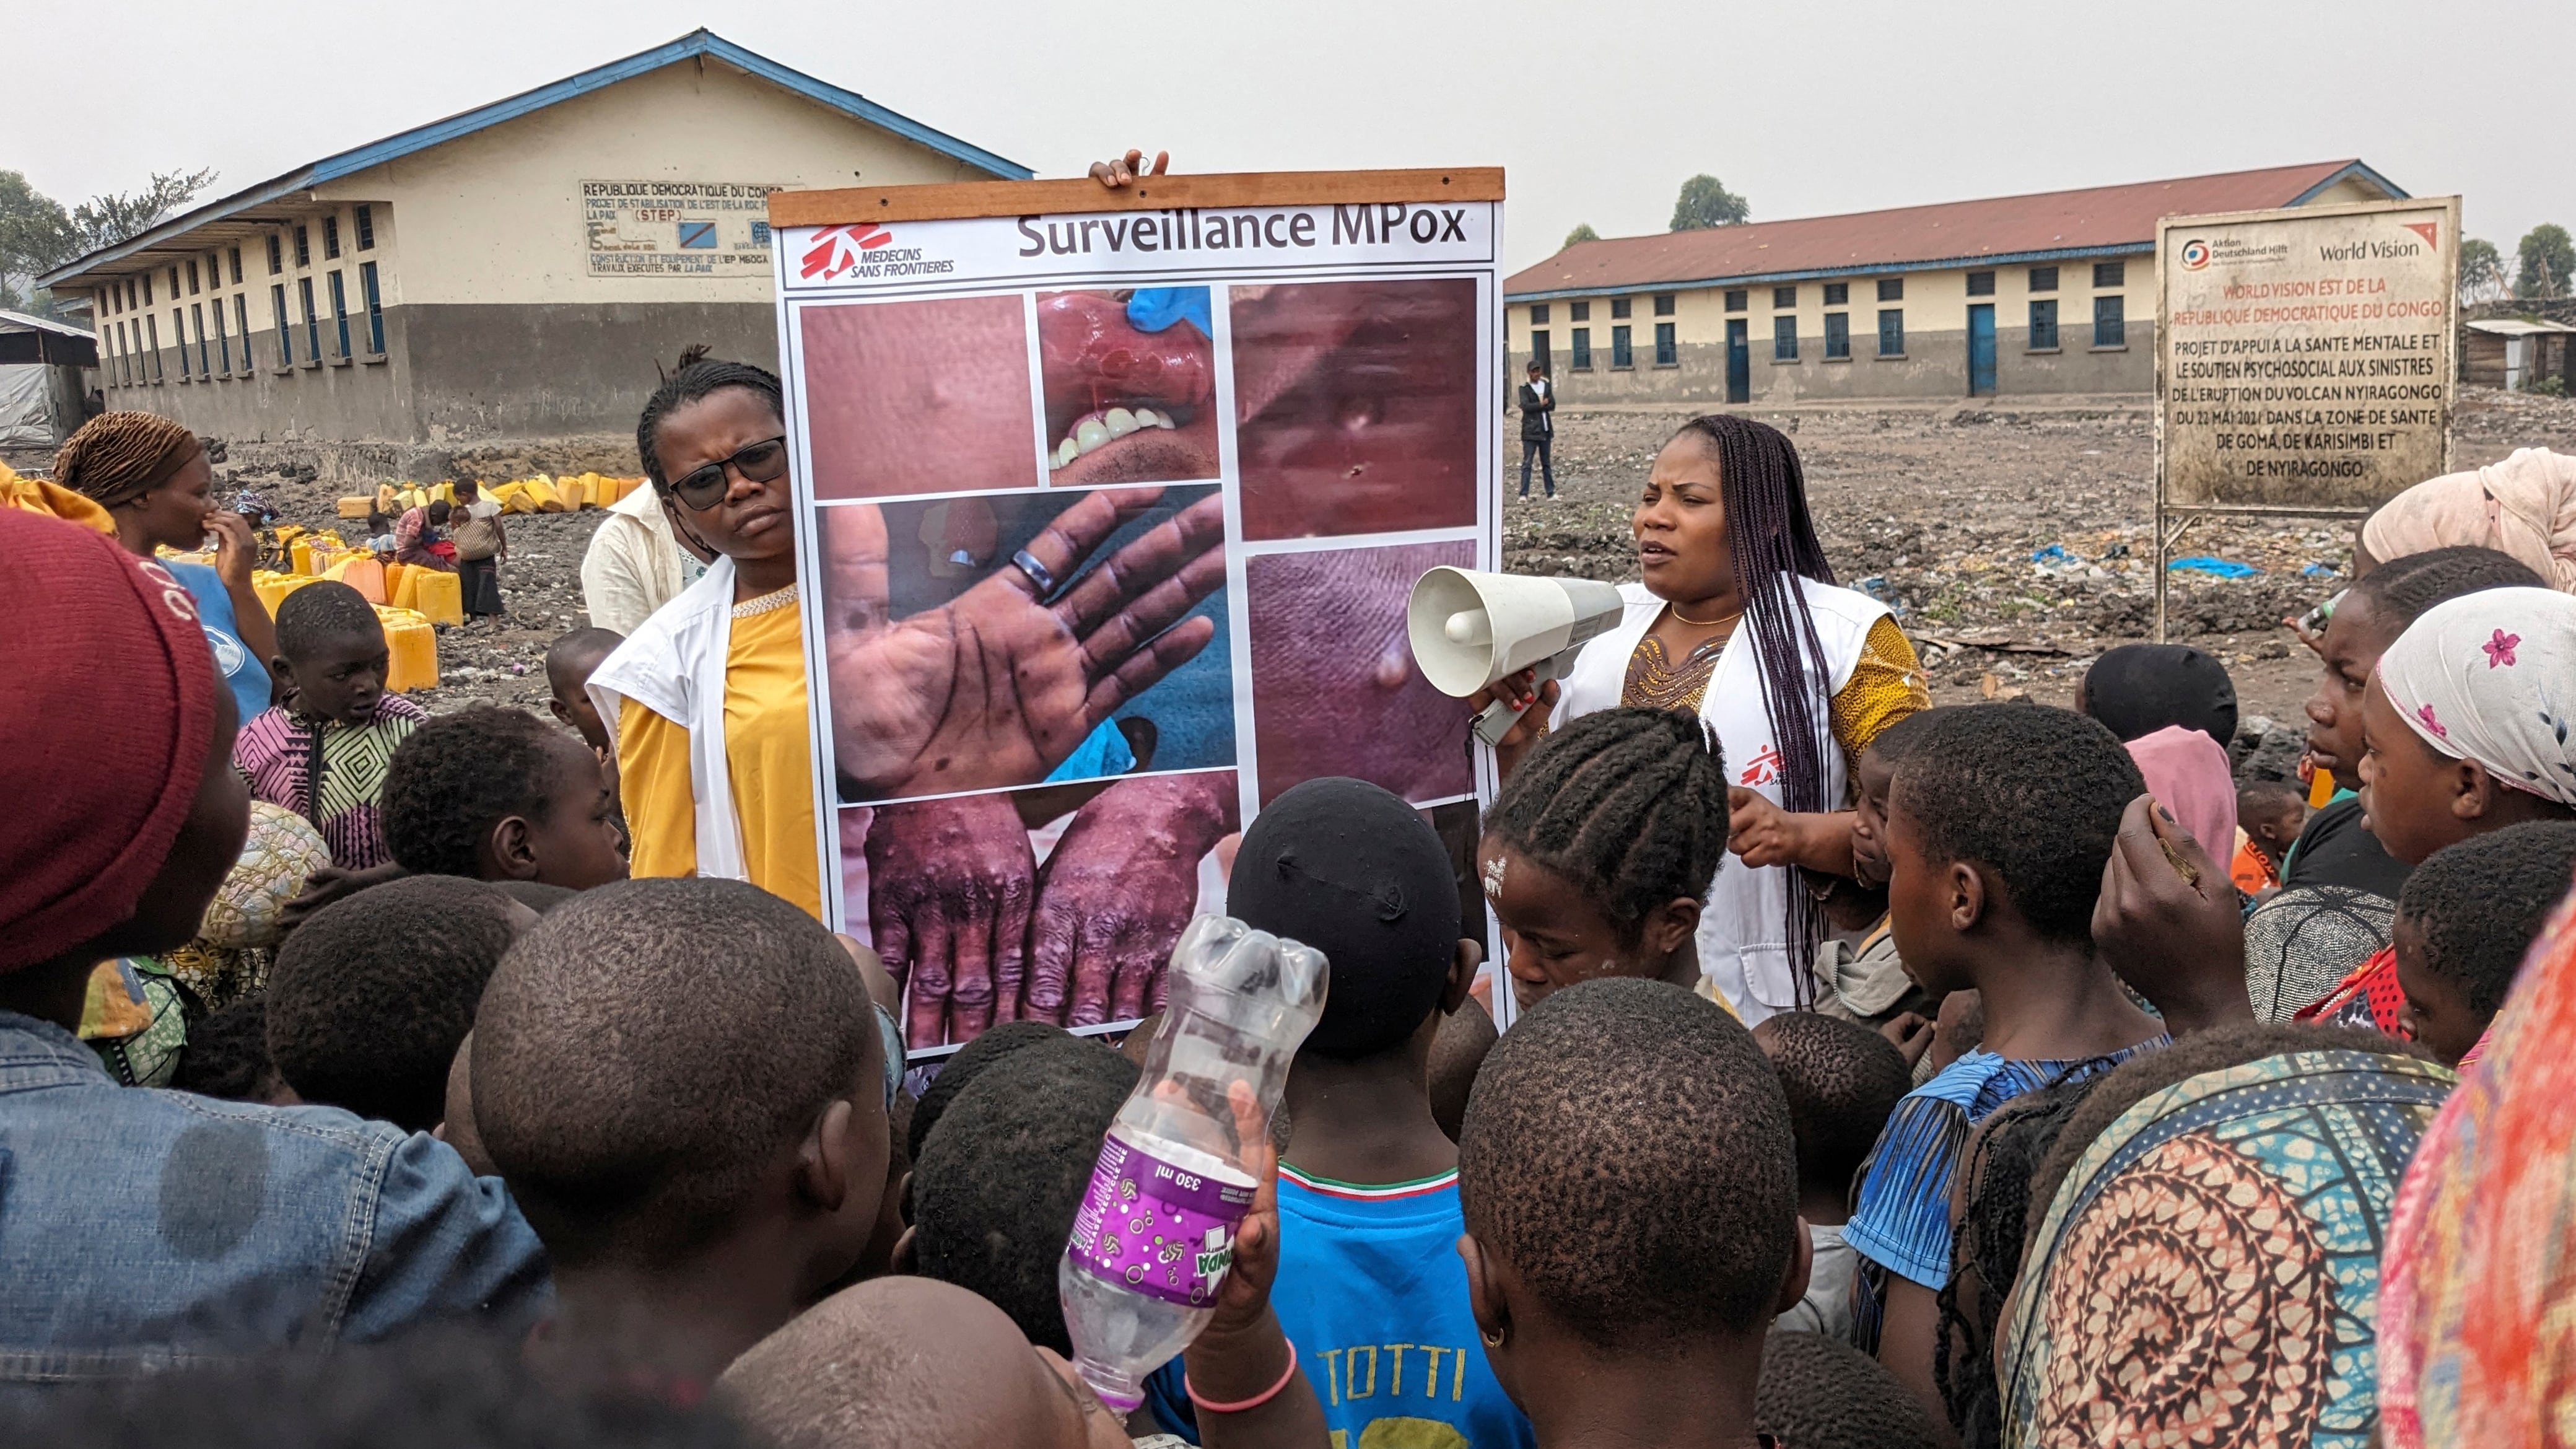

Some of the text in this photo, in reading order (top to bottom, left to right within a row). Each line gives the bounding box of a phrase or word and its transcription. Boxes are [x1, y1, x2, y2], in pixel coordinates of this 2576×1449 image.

[583, 183, 648, 196] REPUBLIQUE
[652, 184, 728, 197] DEMOCRATIQUE
[731, 186, 744, 198] DU
[586, 198, 615, 209] PROJET
[618, 199, 628, 209] DE
[688, 199, 697, 209] DE
[699, 199, 719, 210] L'EST
[586, 209, 681, 221] LA PAIX (STEP)
[1018, 203, 1467, 257] Surveillance MPox
[2212, 239, 2242, 248] Aktion
[2212, 244, 2288, 259] Deutschland Hilft
[2320, 239, 2419, 261] World Vision
[649, 255, 658, 263] ET
[707, 255, 717, 264] DE
[861, 248, 922, 264] MEDECINS
[592, 263, 625, 273] TRAVAUX
[627, 263, 665, 273] EXECUTES
[668, 264, 681, 273] PAR
[685, 265, 694, 273] LA
[851, 260, 954, 278] SANS FRONTIERES
[2224, 277, 2386, 300] WORLD VISION EST DE LA
[2174, 300, 2442, 326] REPUBLIQUE DEMOCRATIQUE DU CONGO
[2175, 333, 2440, 358] PROJET D'APPUI A LA SANTE MENTALE ET
[2176, 357, 2434, 379] LE SOUTIEN PSYCHOSOCIAL AUX SINISTRES
[2172, 384, 2442, 402] DE L'ERUPTION DU VOLCAN NYIRAGONGO
[2177, 409, 2437, 425] DU 22 MAI 2021 DANS LA ZONE DE SANTE
[2216, 432, 2396, 453] DE GOMA, DE KARISIMBI ET
[2246, 460, 2364, 477] DE NYIRAGONGO
[1155, 1164, 1175, 1179] ml
[1176, 1172, 1201, 1191] 330
[1085, 1217, 1103, 1257] PLEASE
[1100, 1167, 1121, 1214] RECYCLE
[1119, 1149, 1129, 1165] ME
[1316, 1343, 1466, 1407] TOTTI
